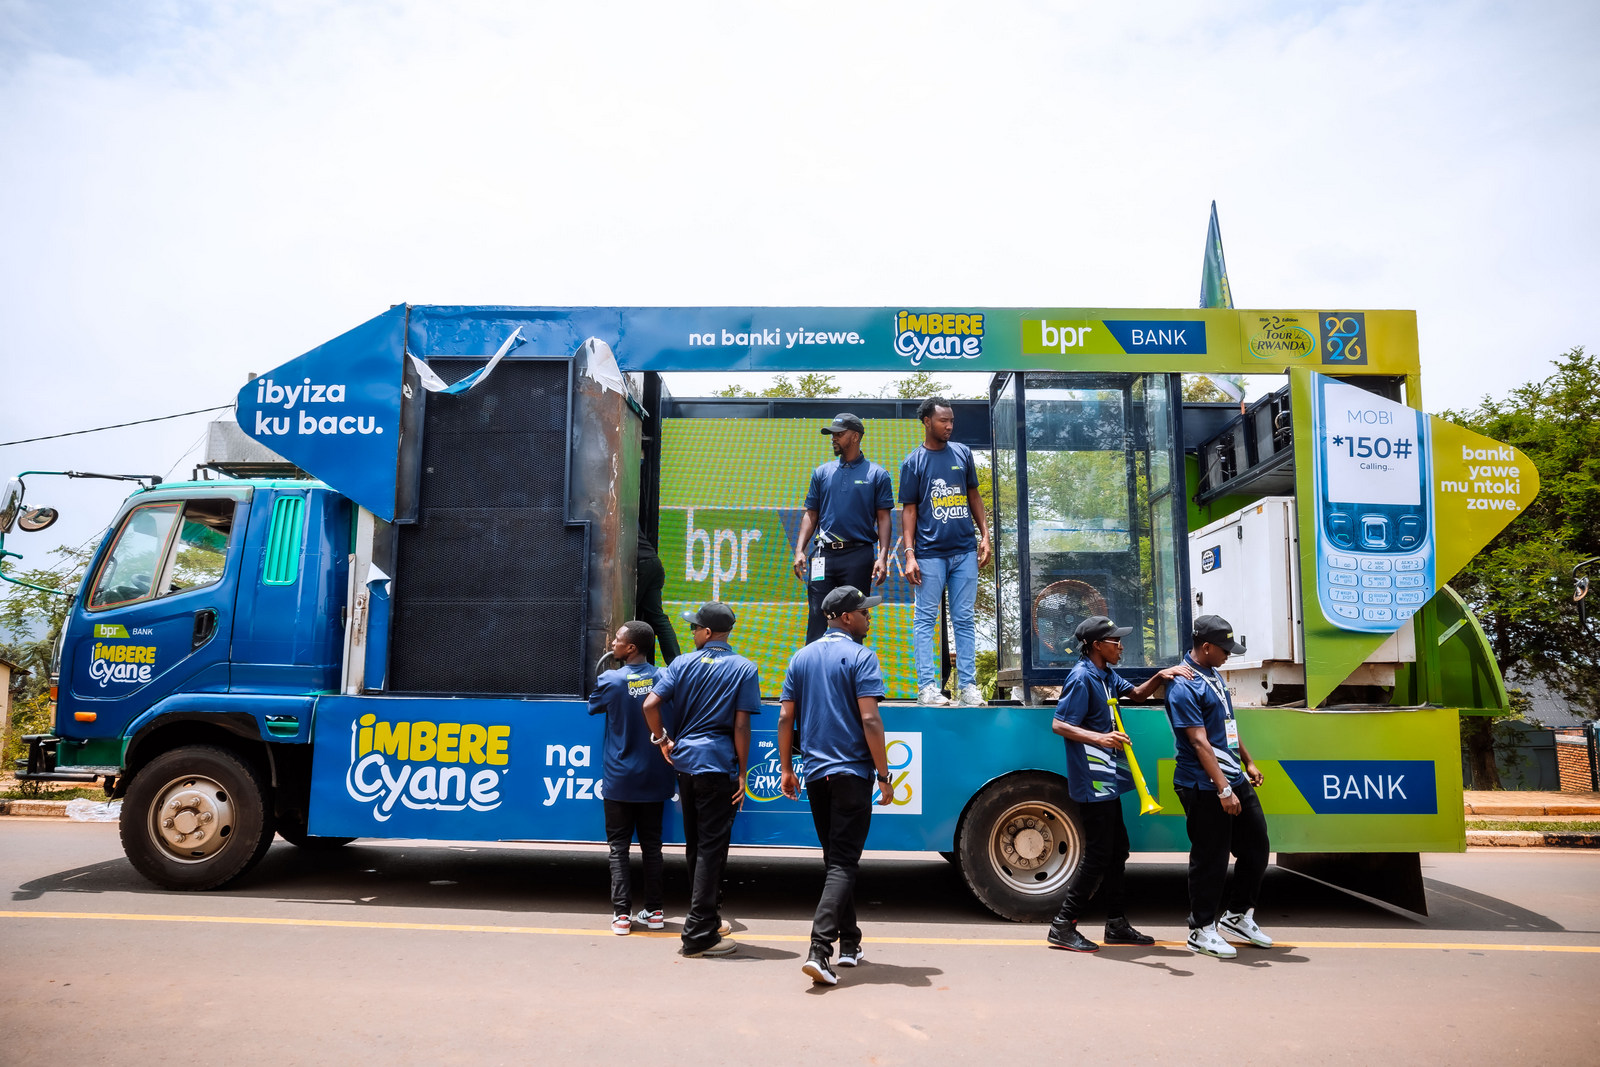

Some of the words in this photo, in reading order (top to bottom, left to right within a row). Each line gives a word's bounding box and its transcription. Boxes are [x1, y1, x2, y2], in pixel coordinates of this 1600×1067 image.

[689, 332, 715, 346] na
[721, 328, 781, 346] banki
[785, 327, 866, 349] yizewe.
[898, 331, 979, 361] Cyane
[1041, 319, 1093, 354] bpr
[1131, 329, 1188, 345] BANK
[1257, 340, 1306, 350] RWANDA
[256, 377, 346, 410] ibyiza
[255, 410, 291, 436] ku
[298, 410, 384, 435] bacu.
[1347, 409, 1393, 425] MOBI
[1462, 444, 1515, 462] banki
[1359, 462, 1395, 472] Calling...
[1468, 465, 1520, 481] yawe
[1440, 480, 1469, 493] mu
[1473, 478, 1520, 495] ntoki
[933, 506, 969, 521] Cyane
[1466, 498, 1521, 511] zawe.
[685, 507, 763, 602] bpr
[100, 624, 119, 638] bpr
[92, 659, 151, 683] Cyane
[545, 744, 591, 767] na
[354, 753, 500, 812] Cyane
[1323, 774, 1407, 800] BANK
